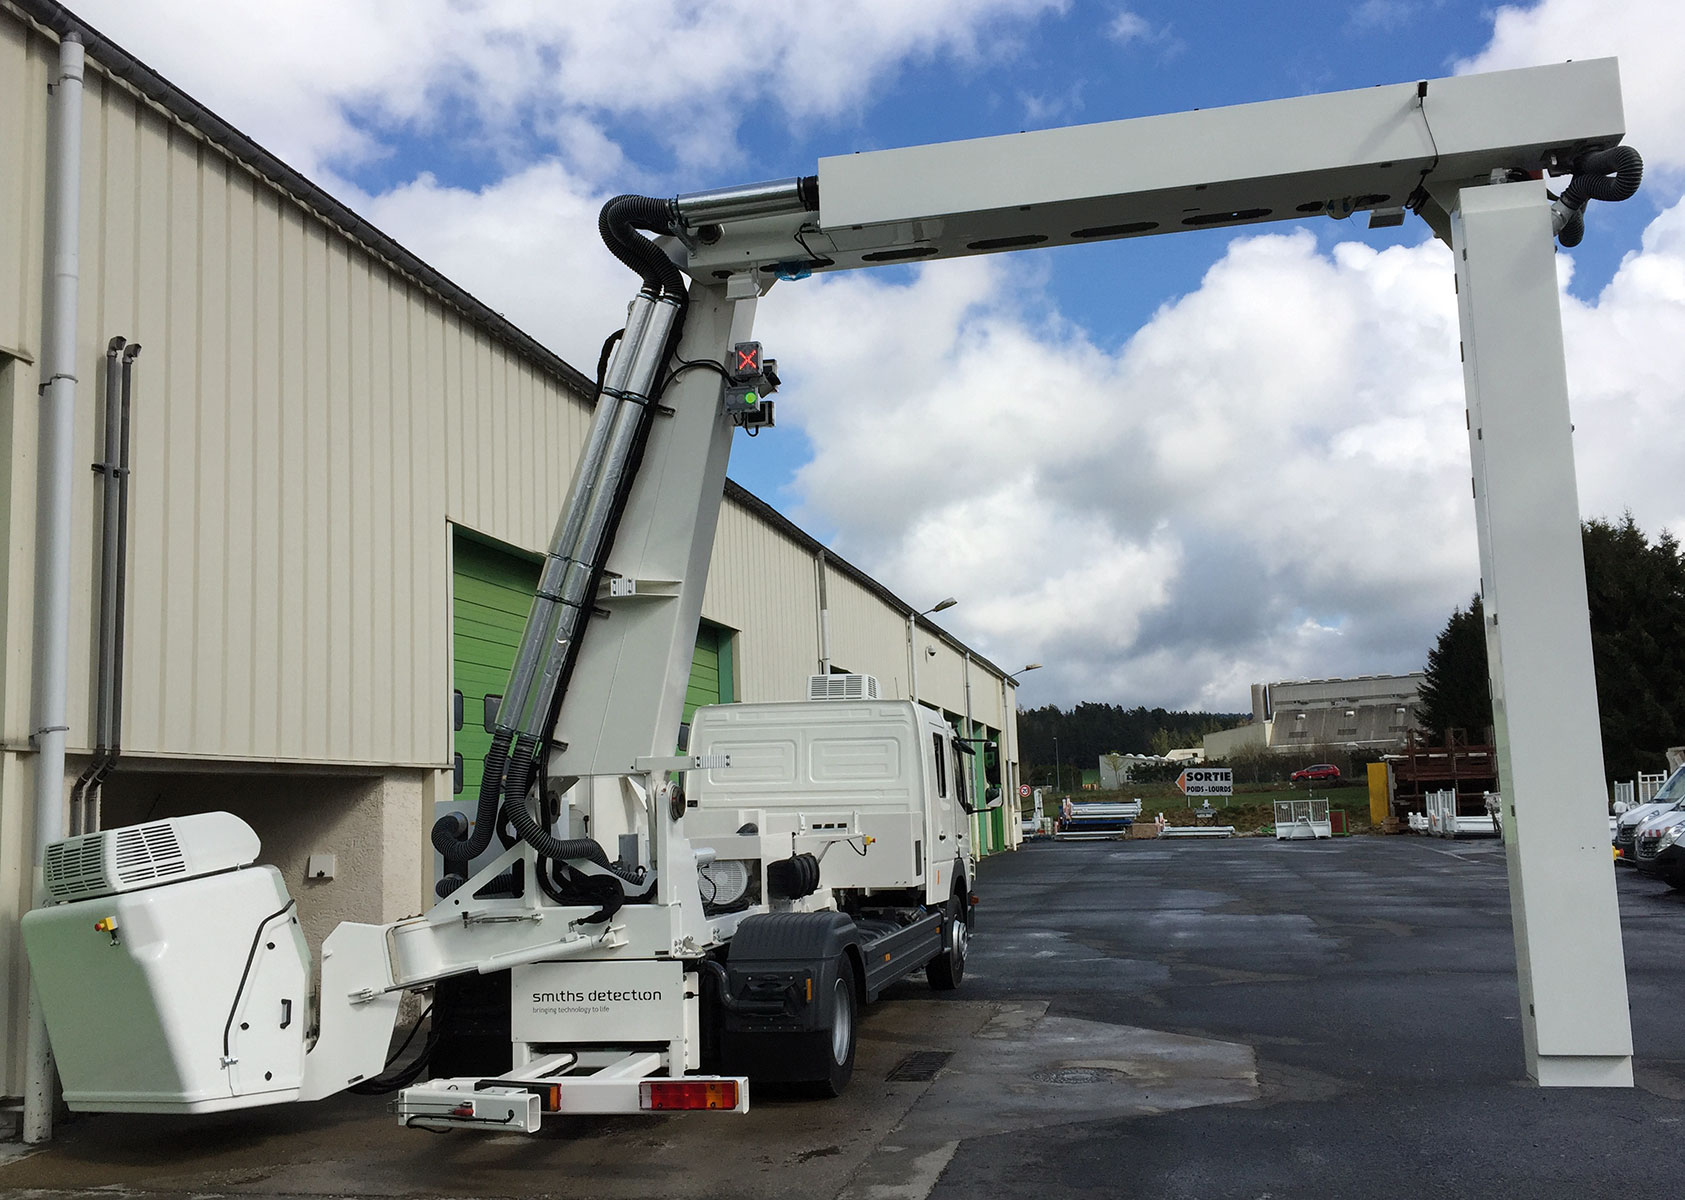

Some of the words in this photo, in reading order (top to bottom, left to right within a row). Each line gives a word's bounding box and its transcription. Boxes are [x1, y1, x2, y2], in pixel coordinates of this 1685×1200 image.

[1186, 772, 1231, 781] SORTIE
[532, 990, 584, 1002] smiths
[588, 990, 662, 1002] detection
[558, 1006, 591, 1014] technology
